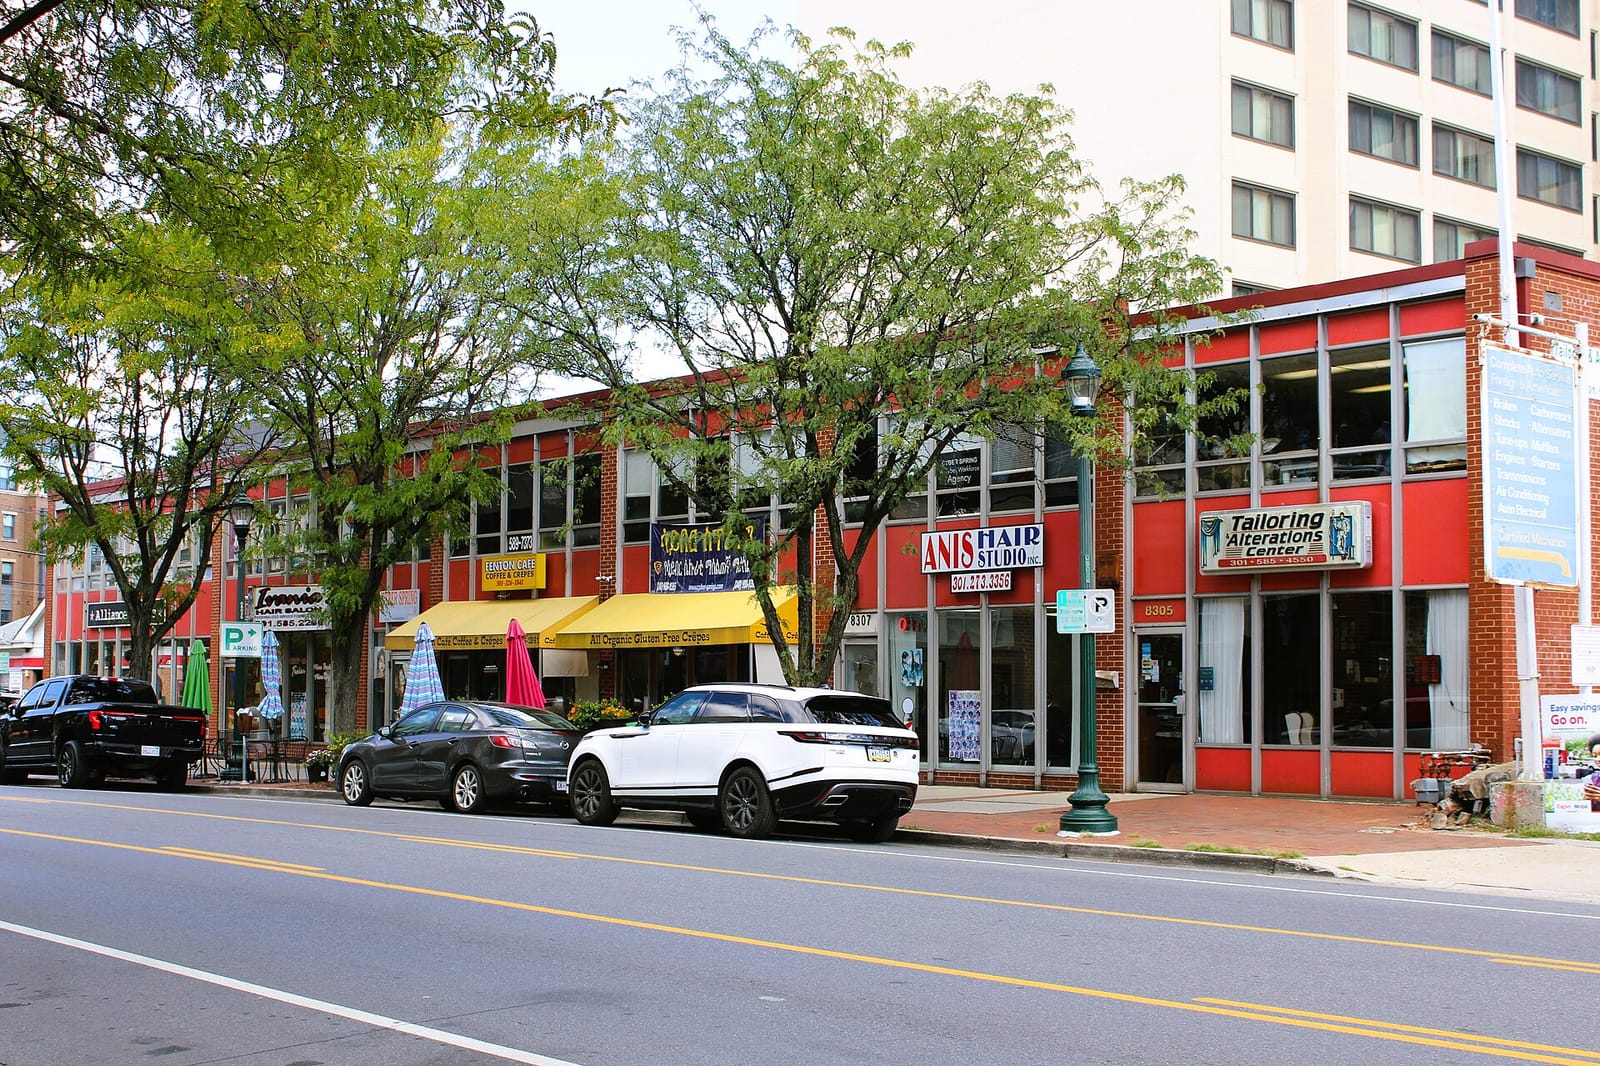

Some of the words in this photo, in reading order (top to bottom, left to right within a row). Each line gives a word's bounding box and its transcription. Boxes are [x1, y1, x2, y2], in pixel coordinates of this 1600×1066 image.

[1493, 397, 1518, 412] Brakes
[1494, 414, 1520, 430] Shocks
[1531, 421, 1571, 439] Alternators
[1496, 450, 1526, 466] Engines
[1532, 455, 1561, 471] Starters
[946, 474, 972, 486] Agency
[1496, 467, 1547, 486] Transmissions
[1496, 485, 1507, 497] Air
[1508, 487, 1550, 506] Conditioning
[1498, 501, 1515, 514] Auto
[1516, 504, 1548, 519] Electrical
[1232, 511, 1325, 531] Tailoring
[1227, 530, 1323, 547] Alterations
[924, 531, 974, 571] ANIS
[978, 527, 1040, 549] HAIR
[1245, 545, 1305, 557] Center
[485, 560, 515, 573] FENTON
[517, 558, 536, 570] CAFE
[978, 548, 1026, 568] STUDIO
[1027, 555, 1042, 565] INC.
[486, 572, 506, 580] COFFEE
[952, 573, 1010, 591] 301.273.3356
[95, 608, 128, 621] Alliance
[1145, 605, 1174, 616] 8305
[850, 614, 871, 626] 8307
[453, 636, 472, 646] Coffee
[590, 635, 601, 645] All
[603, 634, 632, 648] Organic
[634, 633, 660, 644] Gluten
[662, 632, 679, 642] Free
[1550, 703, 1568, 714] Easy
[1570, 702, 1600, 713] savings
[1551, 714, 1568, 725] Go
[1570, 715, 1588, 725] on.
